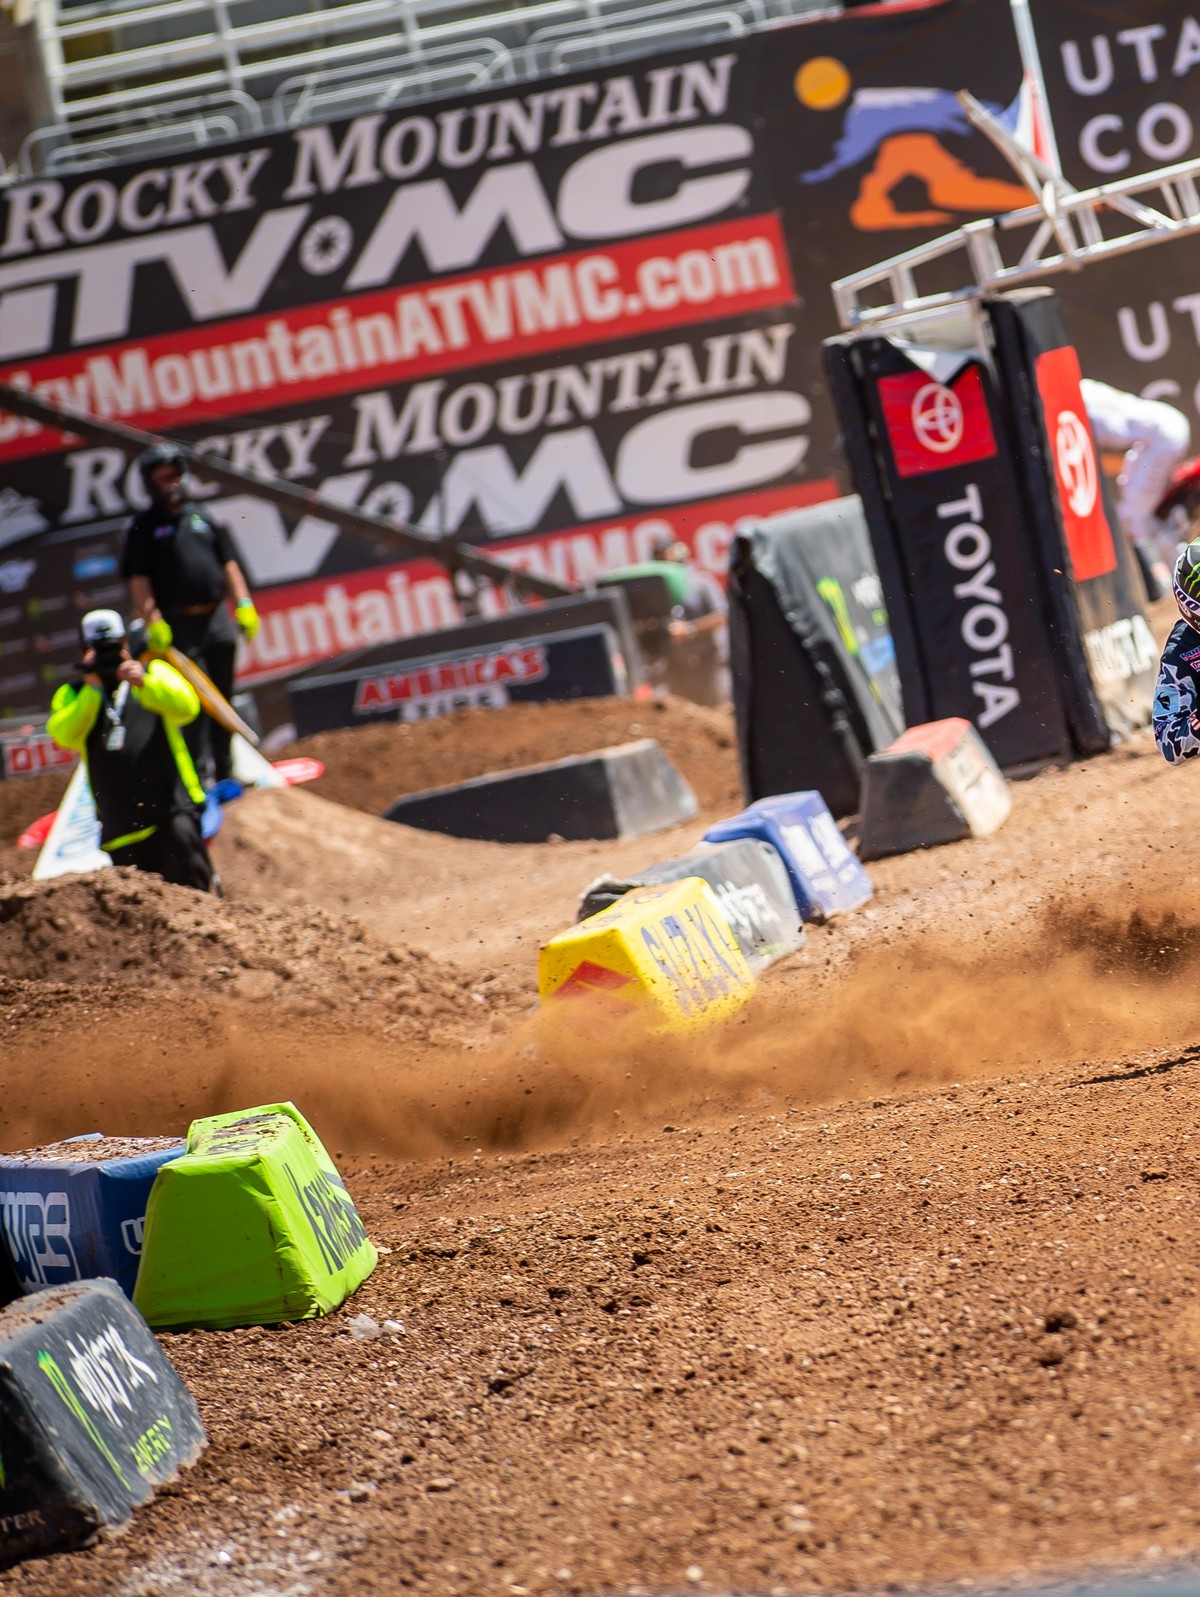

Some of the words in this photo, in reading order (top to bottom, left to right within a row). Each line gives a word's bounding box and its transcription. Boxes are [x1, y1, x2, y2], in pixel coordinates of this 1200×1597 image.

[3, 148, 272, 254] ROCKY
[287, 54, 740, 197] MOUNTAIN
[344, 324, 796, 468] MOUNTAIN
[354, 641, 549, 714] AMERICA'S
[936, 483, 1021, 729] TOYOTA
